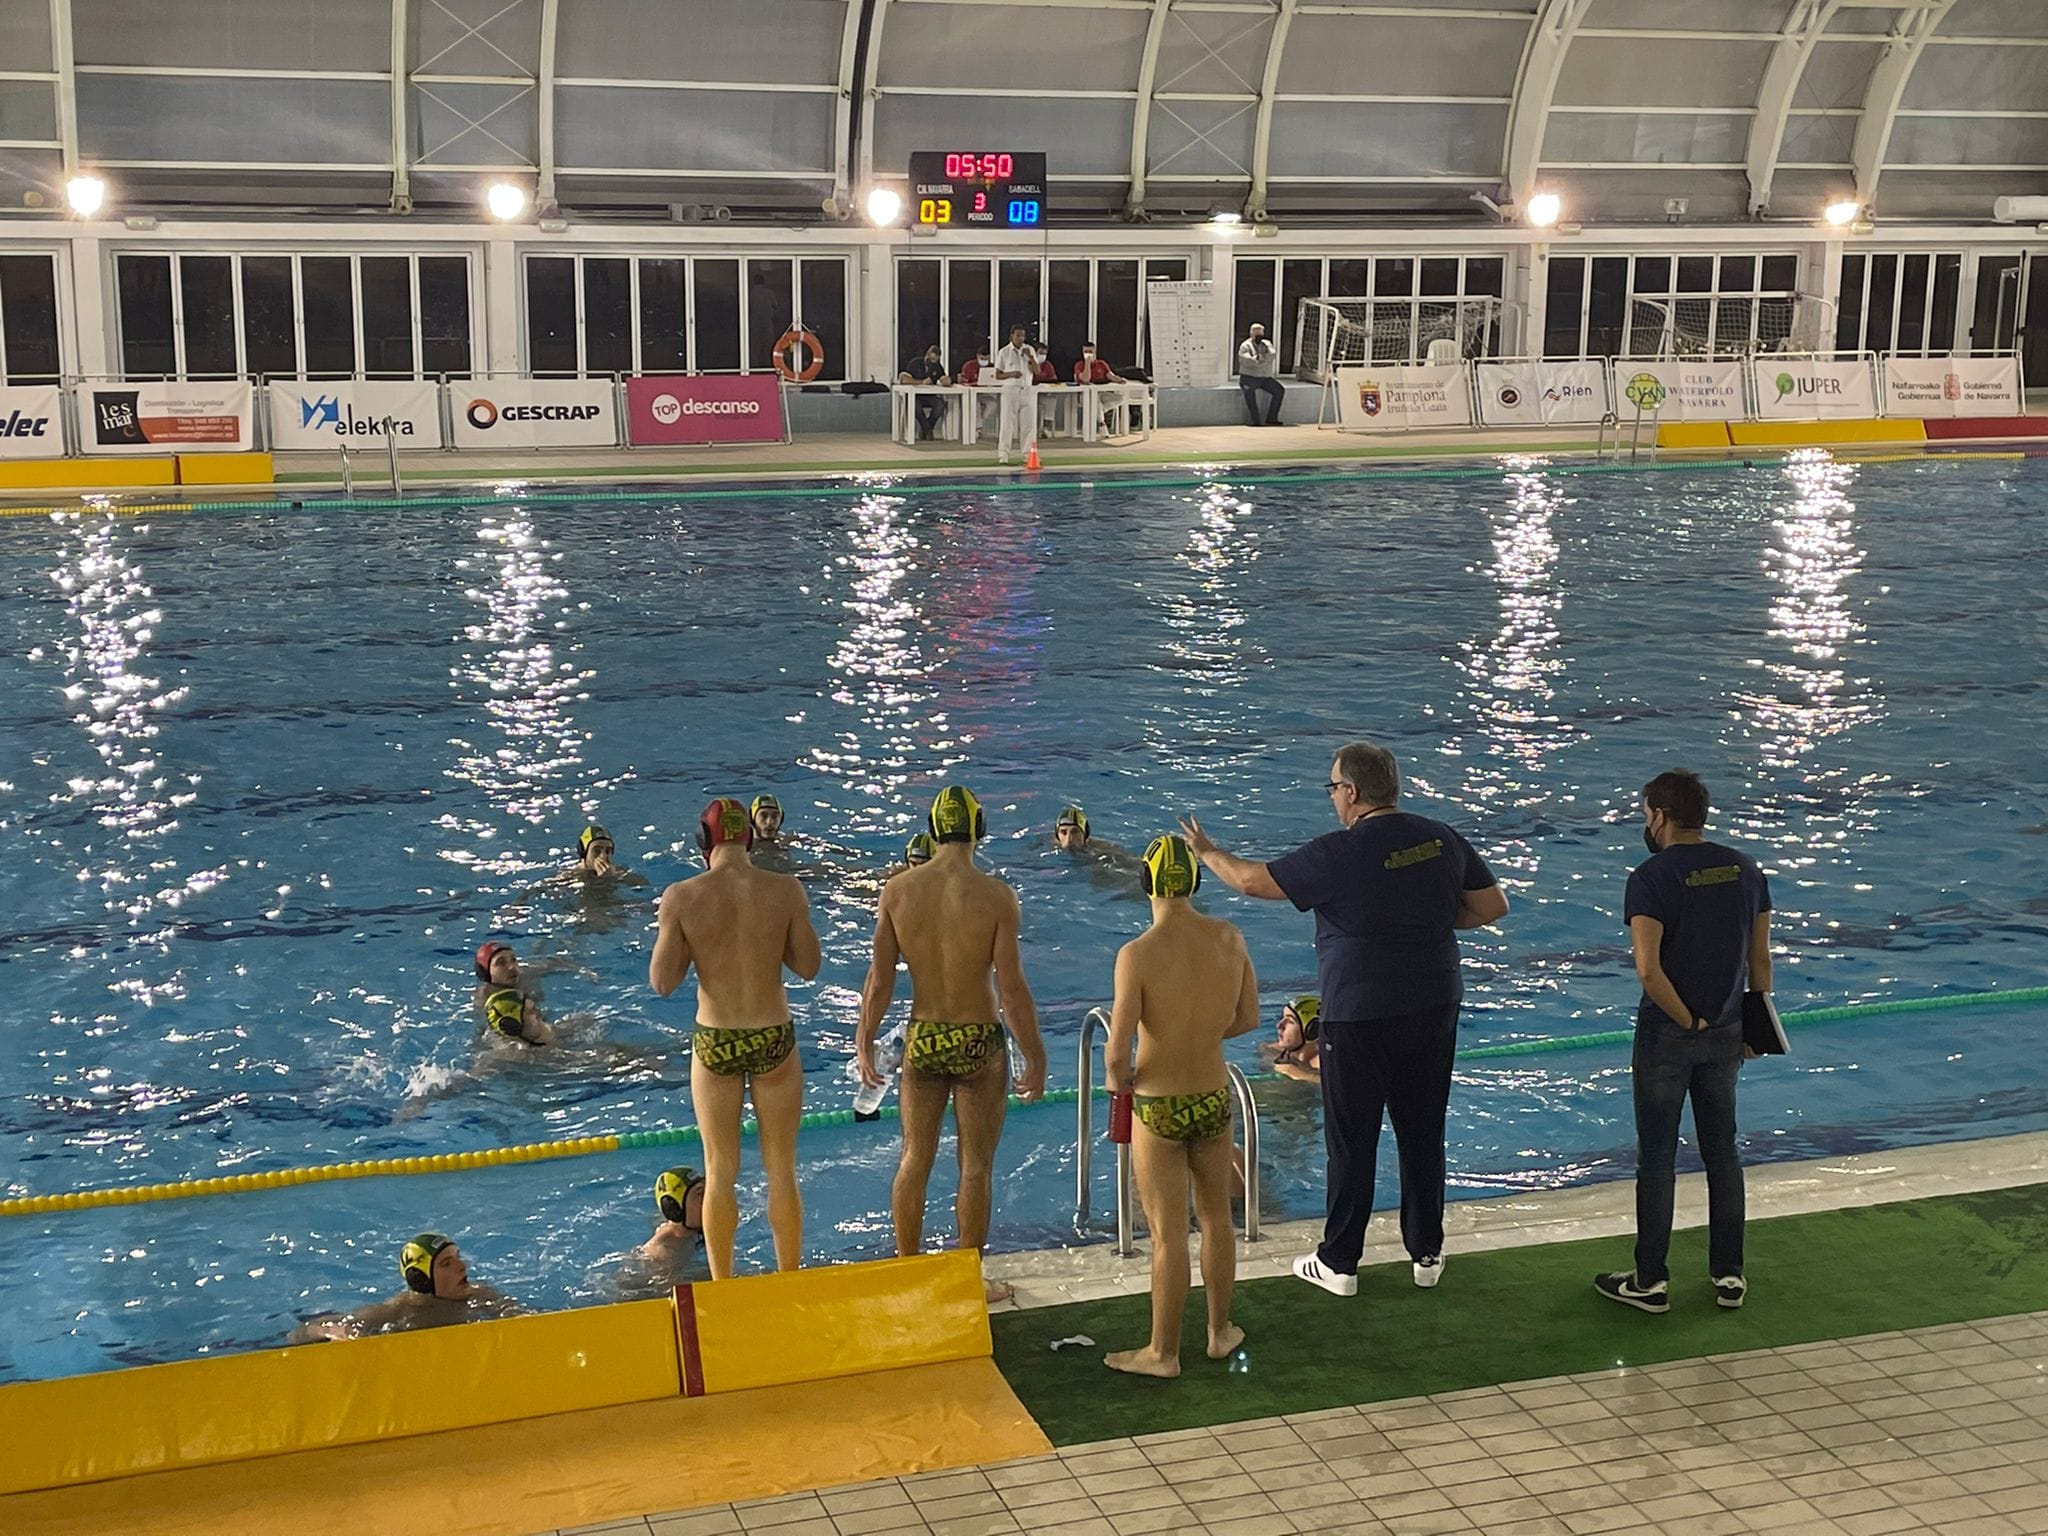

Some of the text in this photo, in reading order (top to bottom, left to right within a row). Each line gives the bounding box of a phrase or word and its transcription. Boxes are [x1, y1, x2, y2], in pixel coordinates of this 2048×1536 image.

[946, 153, 1013, 178] 05:50
[974, 192, 987, 211] 3
[920, 199, 951, 223] 03
[1008, 200, 1040, 223] 08
[1685, 375, 1713, 385] CLUB
[1797, 377, 1842, 397] JUPER
[1963, 381, 2003, 390] Gobierno
[1386, 390, 1446, 405] Pamplona
[1669, 386, 1735, 397] WATERPOLO
[1976, 392, 2011, 400] Navarra
[100, 403, 132, 419] les
[654, 397, 760, 416] TOP descanso
[1679, 398, 1727, 408] NAVARRA
[102, 411, 134, 430] mar
[335, 403, 415, 435] elektra
[501, 405, 600, 421] GESCRAP
[966, 1041, 985, 1057] 50
